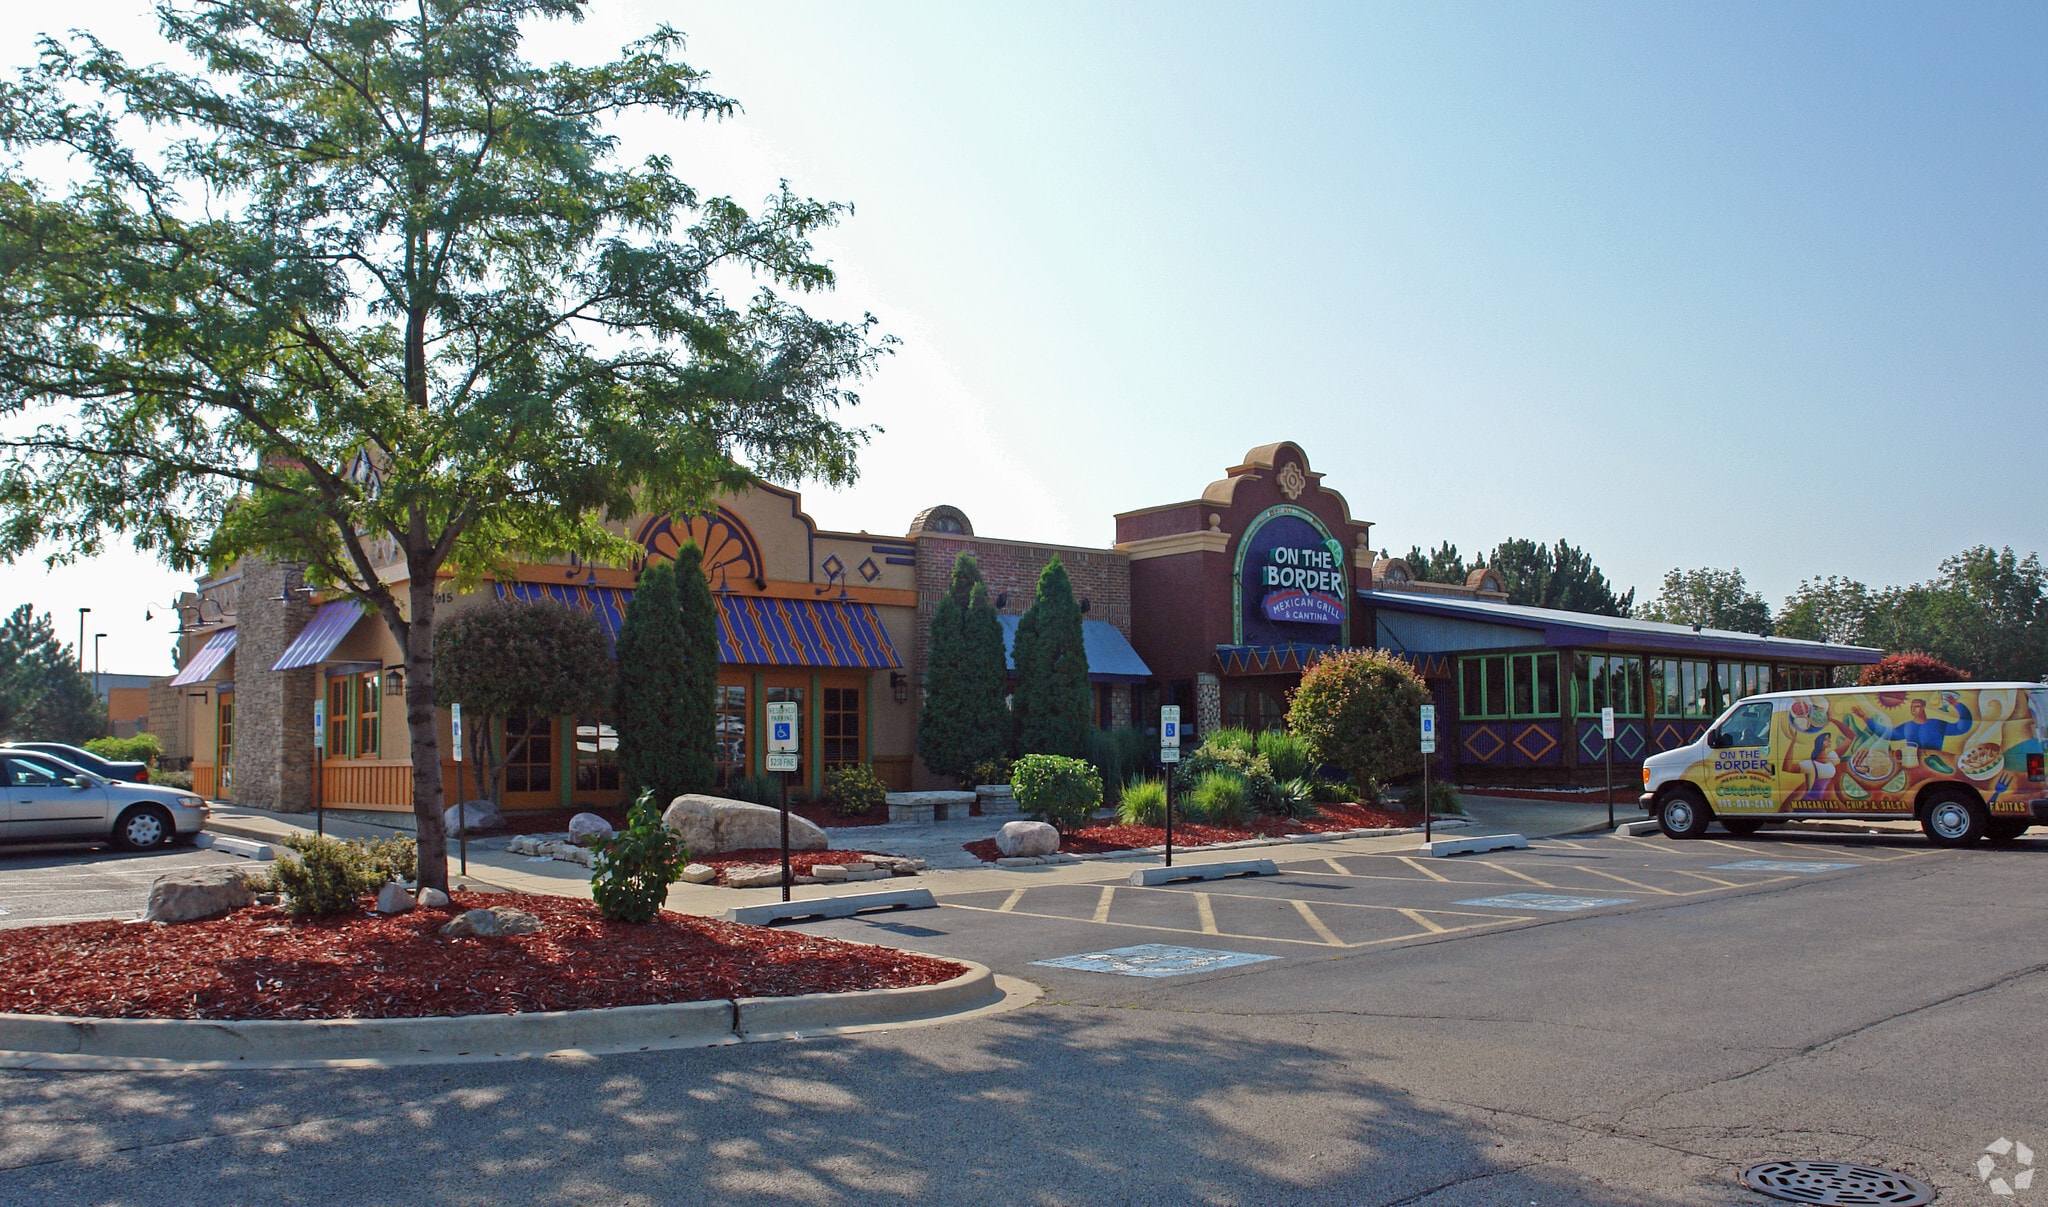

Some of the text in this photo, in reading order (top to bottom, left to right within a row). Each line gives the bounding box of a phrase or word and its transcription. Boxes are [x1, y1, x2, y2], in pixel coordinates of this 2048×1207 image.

[1275, 547, 1331, 568] ON THE
[1268, 566, 1345, 600] BORDER
[1273, 598, 1340, 619] MEXICAN GRILL
[1285, 611, 1328, 621] & CANTINA
[1719, 750, 1761, 760] ON THE
[784, 758, 794, 766] FINE
[1715, 760, 1771, 773] BORDER
[1721, 775, 1765, 783] MEXICAN GRILL
[1716, 784, 1771, 798] Catering
[1791, 801, 1908, 810] MARGARITAS CHIPS & SALSA
[1989, 802, 2025, 812] FAJITAS
